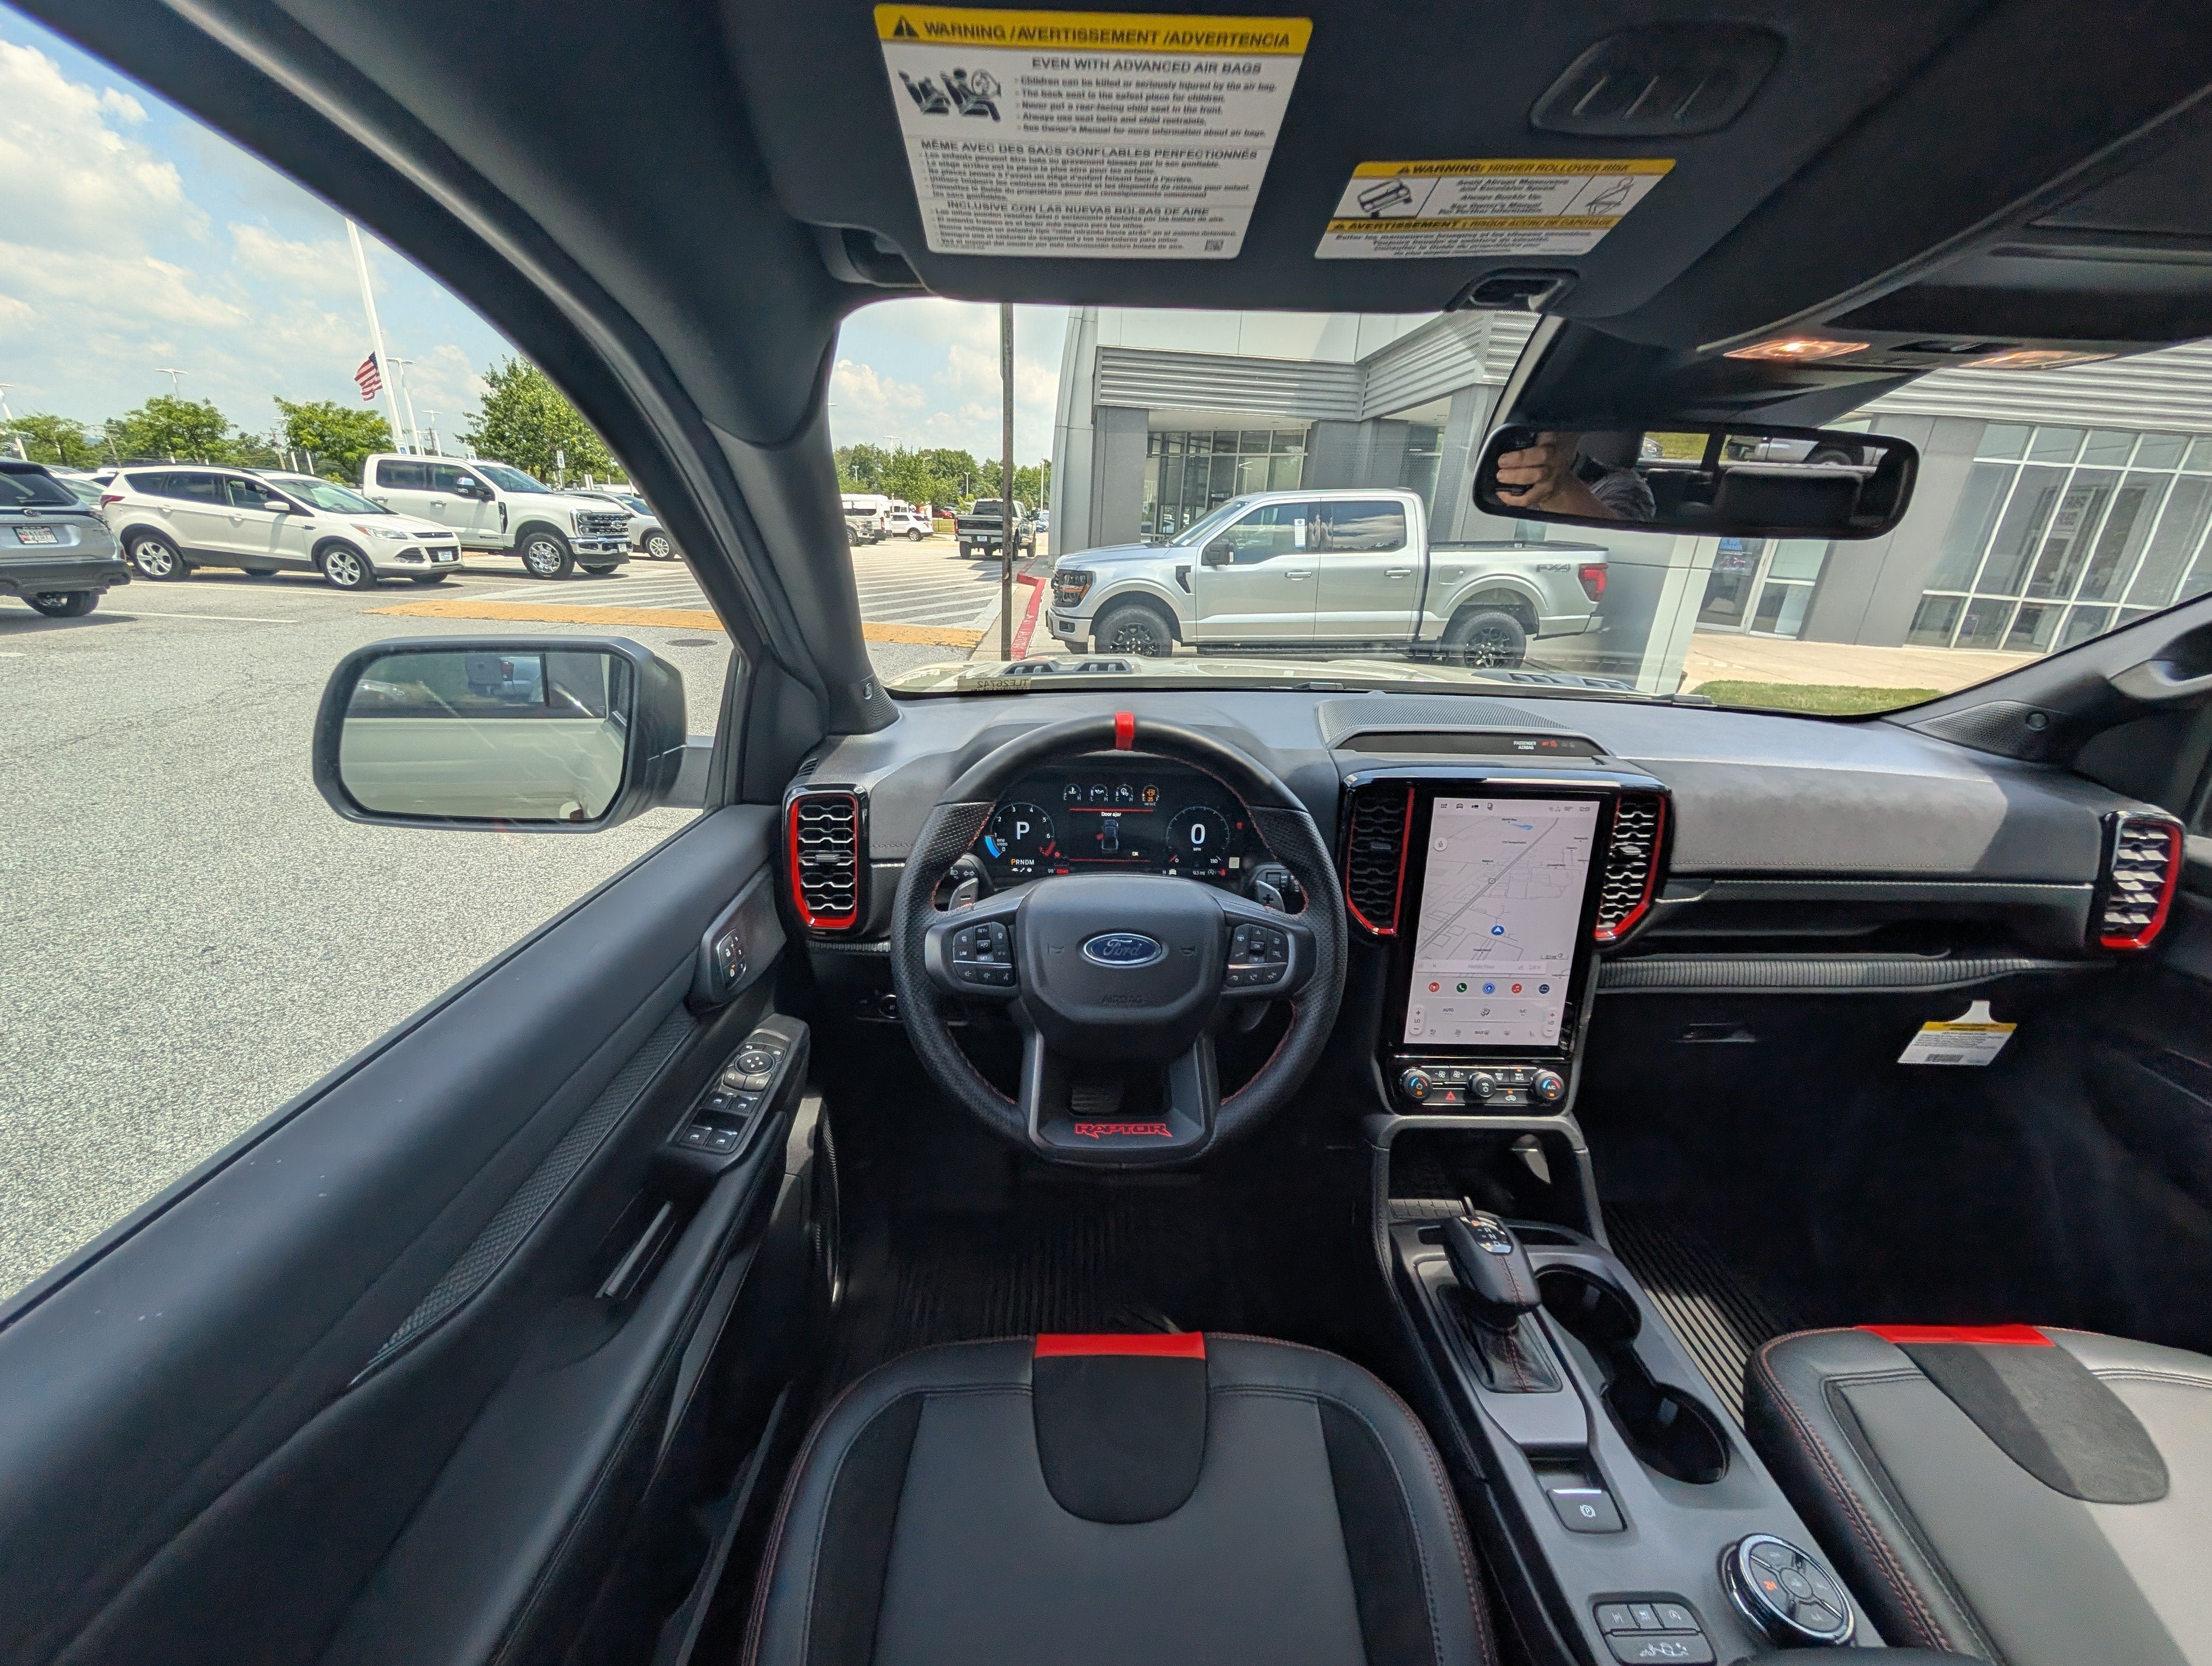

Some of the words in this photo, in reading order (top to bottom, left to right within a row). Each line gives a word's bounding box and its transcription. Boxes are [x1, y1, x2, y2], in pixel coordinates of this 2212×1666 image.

[924, 20, 1006, 41] WARNING
[1032, 57, 1070, 70] EVEN
[1074, 58, 1110, 71] WITH
[1113, 59, 1191, 74] ADVANCED
[1193, 60, 1218, 74] AIR
[1222, 62, 1262, 75] BAGS
[962, 142, 995, 153] AVEC
[999, 144, 1024, 155] DES
[1027, 145, 1062, 156] SACS
[1065, 146, 1150, 158] GONFLABLES
[947, 201, 1009, 212] INCLUSIVE
[1011, 203, 1036, 213] CON
[1039, 204, 1062, 214] LAS
[1065, 204, 1111, 215] NUEVAS
[1115, 206, 1161, 215] BOLSAS
[1165, 207, 1180, 215] DE
[1182, 207, 1210, 216] AIRE
[1347, 218, 1458, 230] AVERTISSEMENT
[1535, 563, 1571, 573] FX4
[1017, 821, 1030, 840] P
[1191, 823, 1206, 844] 0
[1103, 939, 1142, 956] Ford
[1075, 1123, 1173, 1139] RAPTOR
